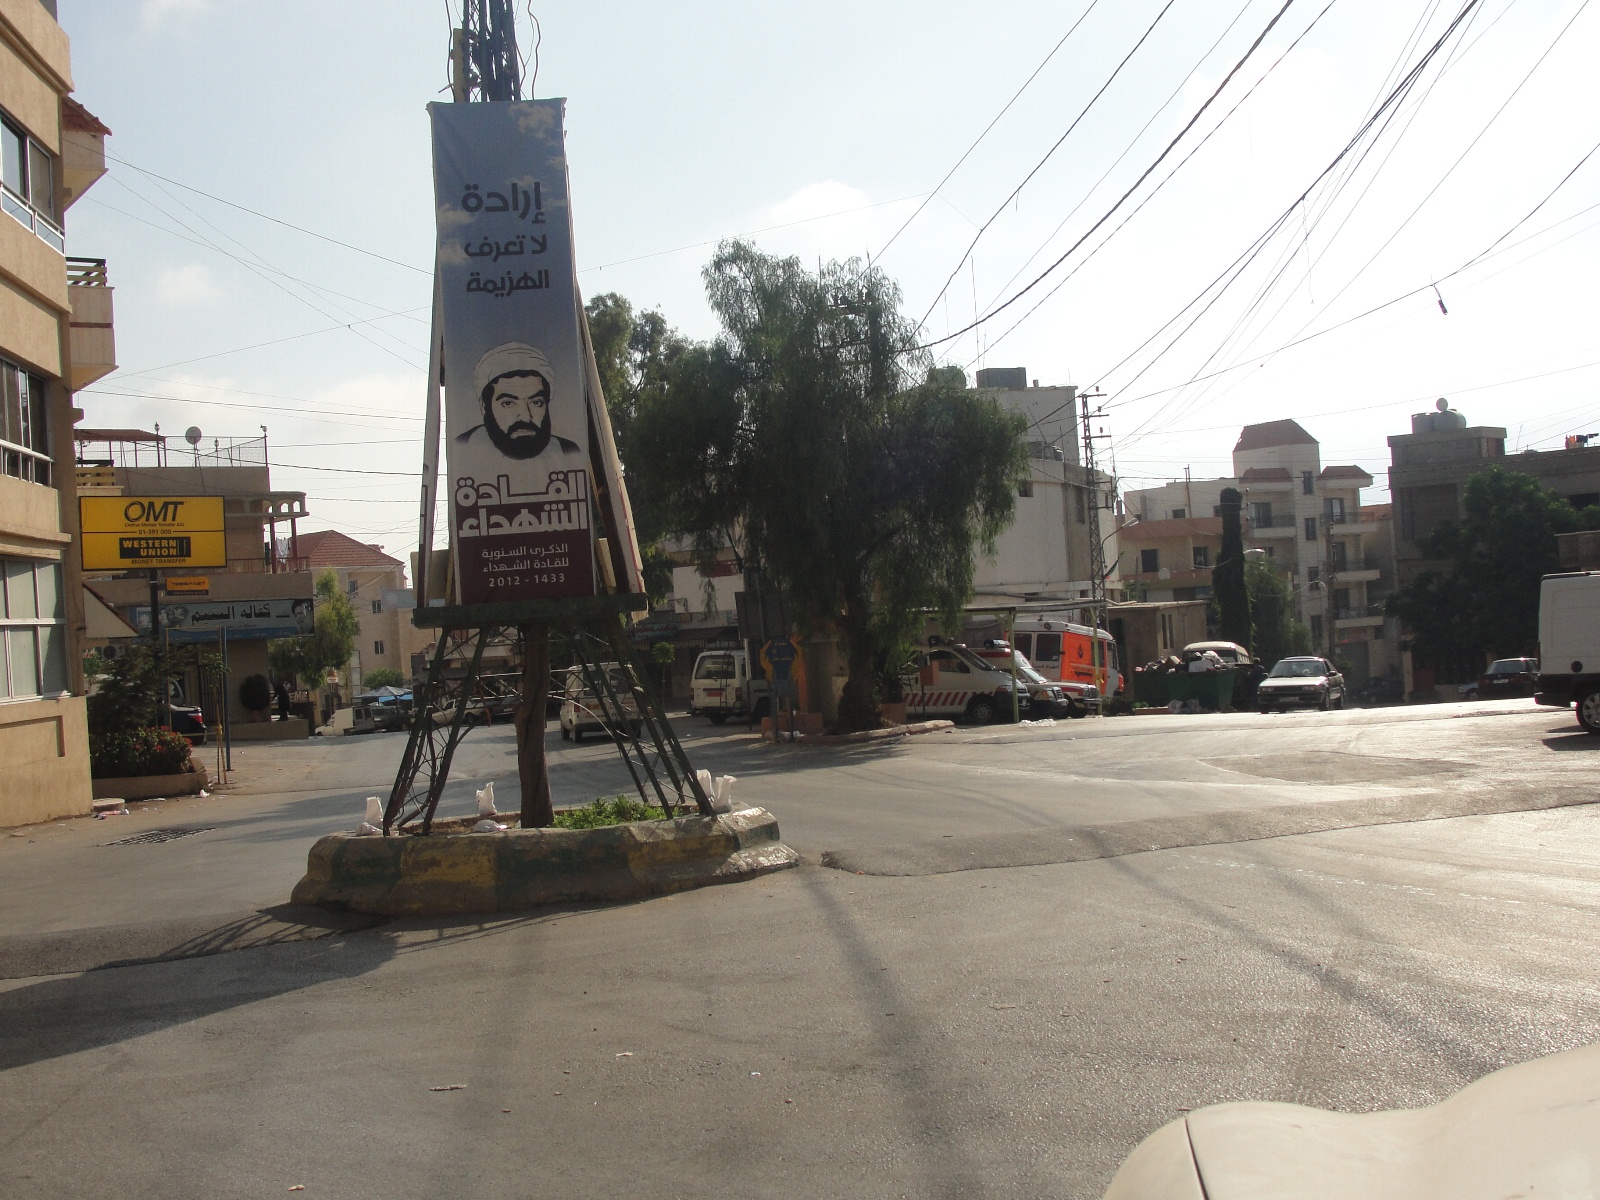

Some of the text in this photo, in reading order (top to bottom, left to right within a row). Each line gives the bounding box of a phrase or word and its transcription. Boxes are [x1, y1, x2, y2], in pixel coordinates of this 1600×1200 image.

[461, 181, 546, 225] إرادة
[463, 234, 547, 263] لا تعرف
[466, 268, 550, 298] الهزيمة
[455, 469, 587, 507] القادة
[124, 500, 184, 523] OMT
[458, 501, 588, 538] الشهداء
[122, 539, 177, 548] WESTERN
[140, 548, 177, 556] UNION
[481, 543, 569, 560] الذكرى السنوية
[483, 557, 569, 573] للقادة الشهداء
[489, 576, 521, 587] 2012
[534, 573, 565, 584] 1433
[191, 602, 271, 626] كفالة اليتيم
